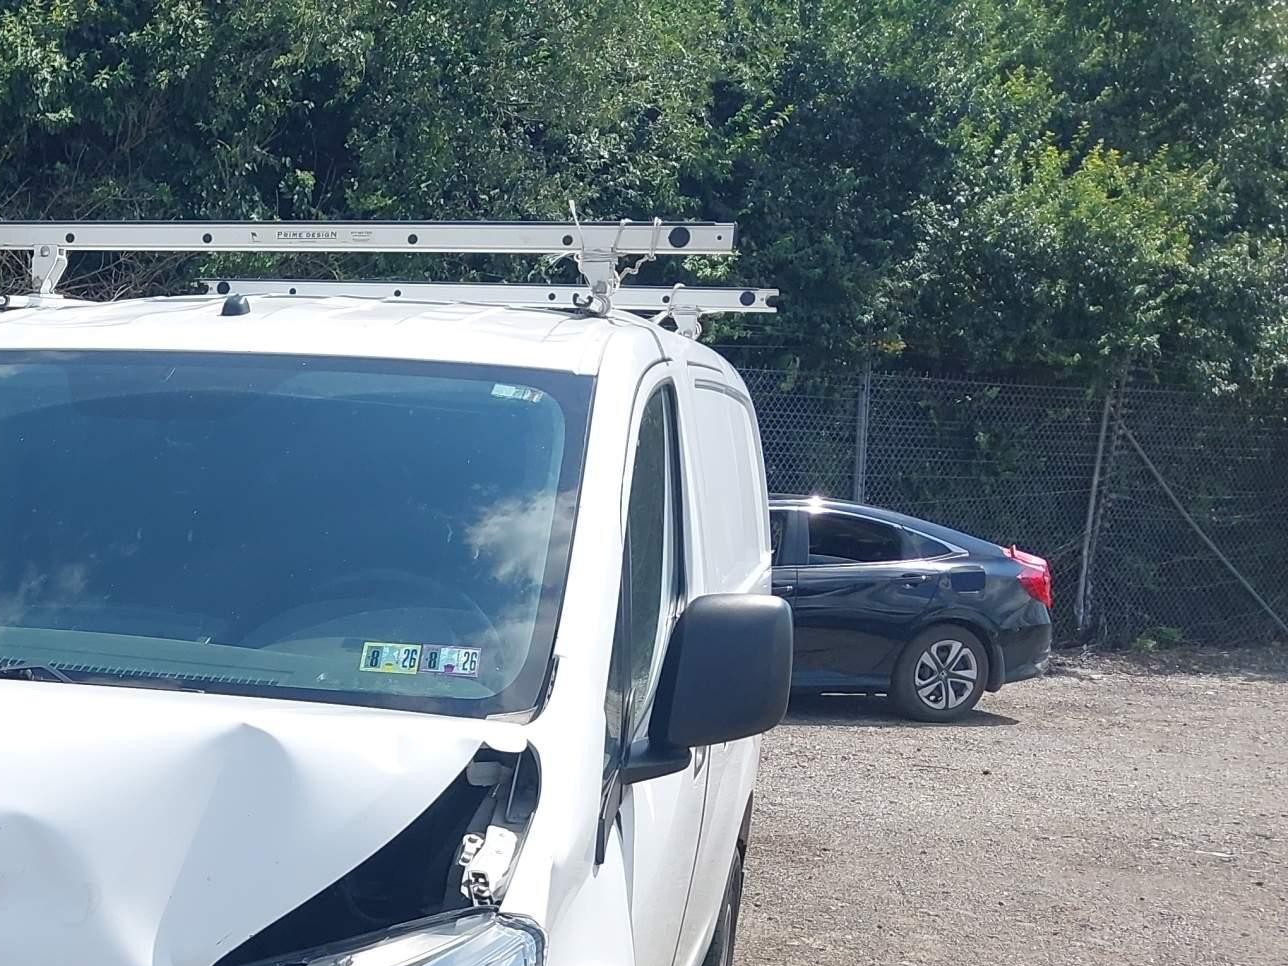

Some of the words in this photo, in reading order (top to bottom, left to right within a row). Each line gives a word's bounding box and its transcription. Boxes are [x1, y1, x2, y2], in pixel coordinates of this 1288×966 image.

[369, 649, 381, 668] 8
[401, 648, 418, 669] 26
[427, 651, 438, 669] 8
[461, 651, 478, 671] 26
